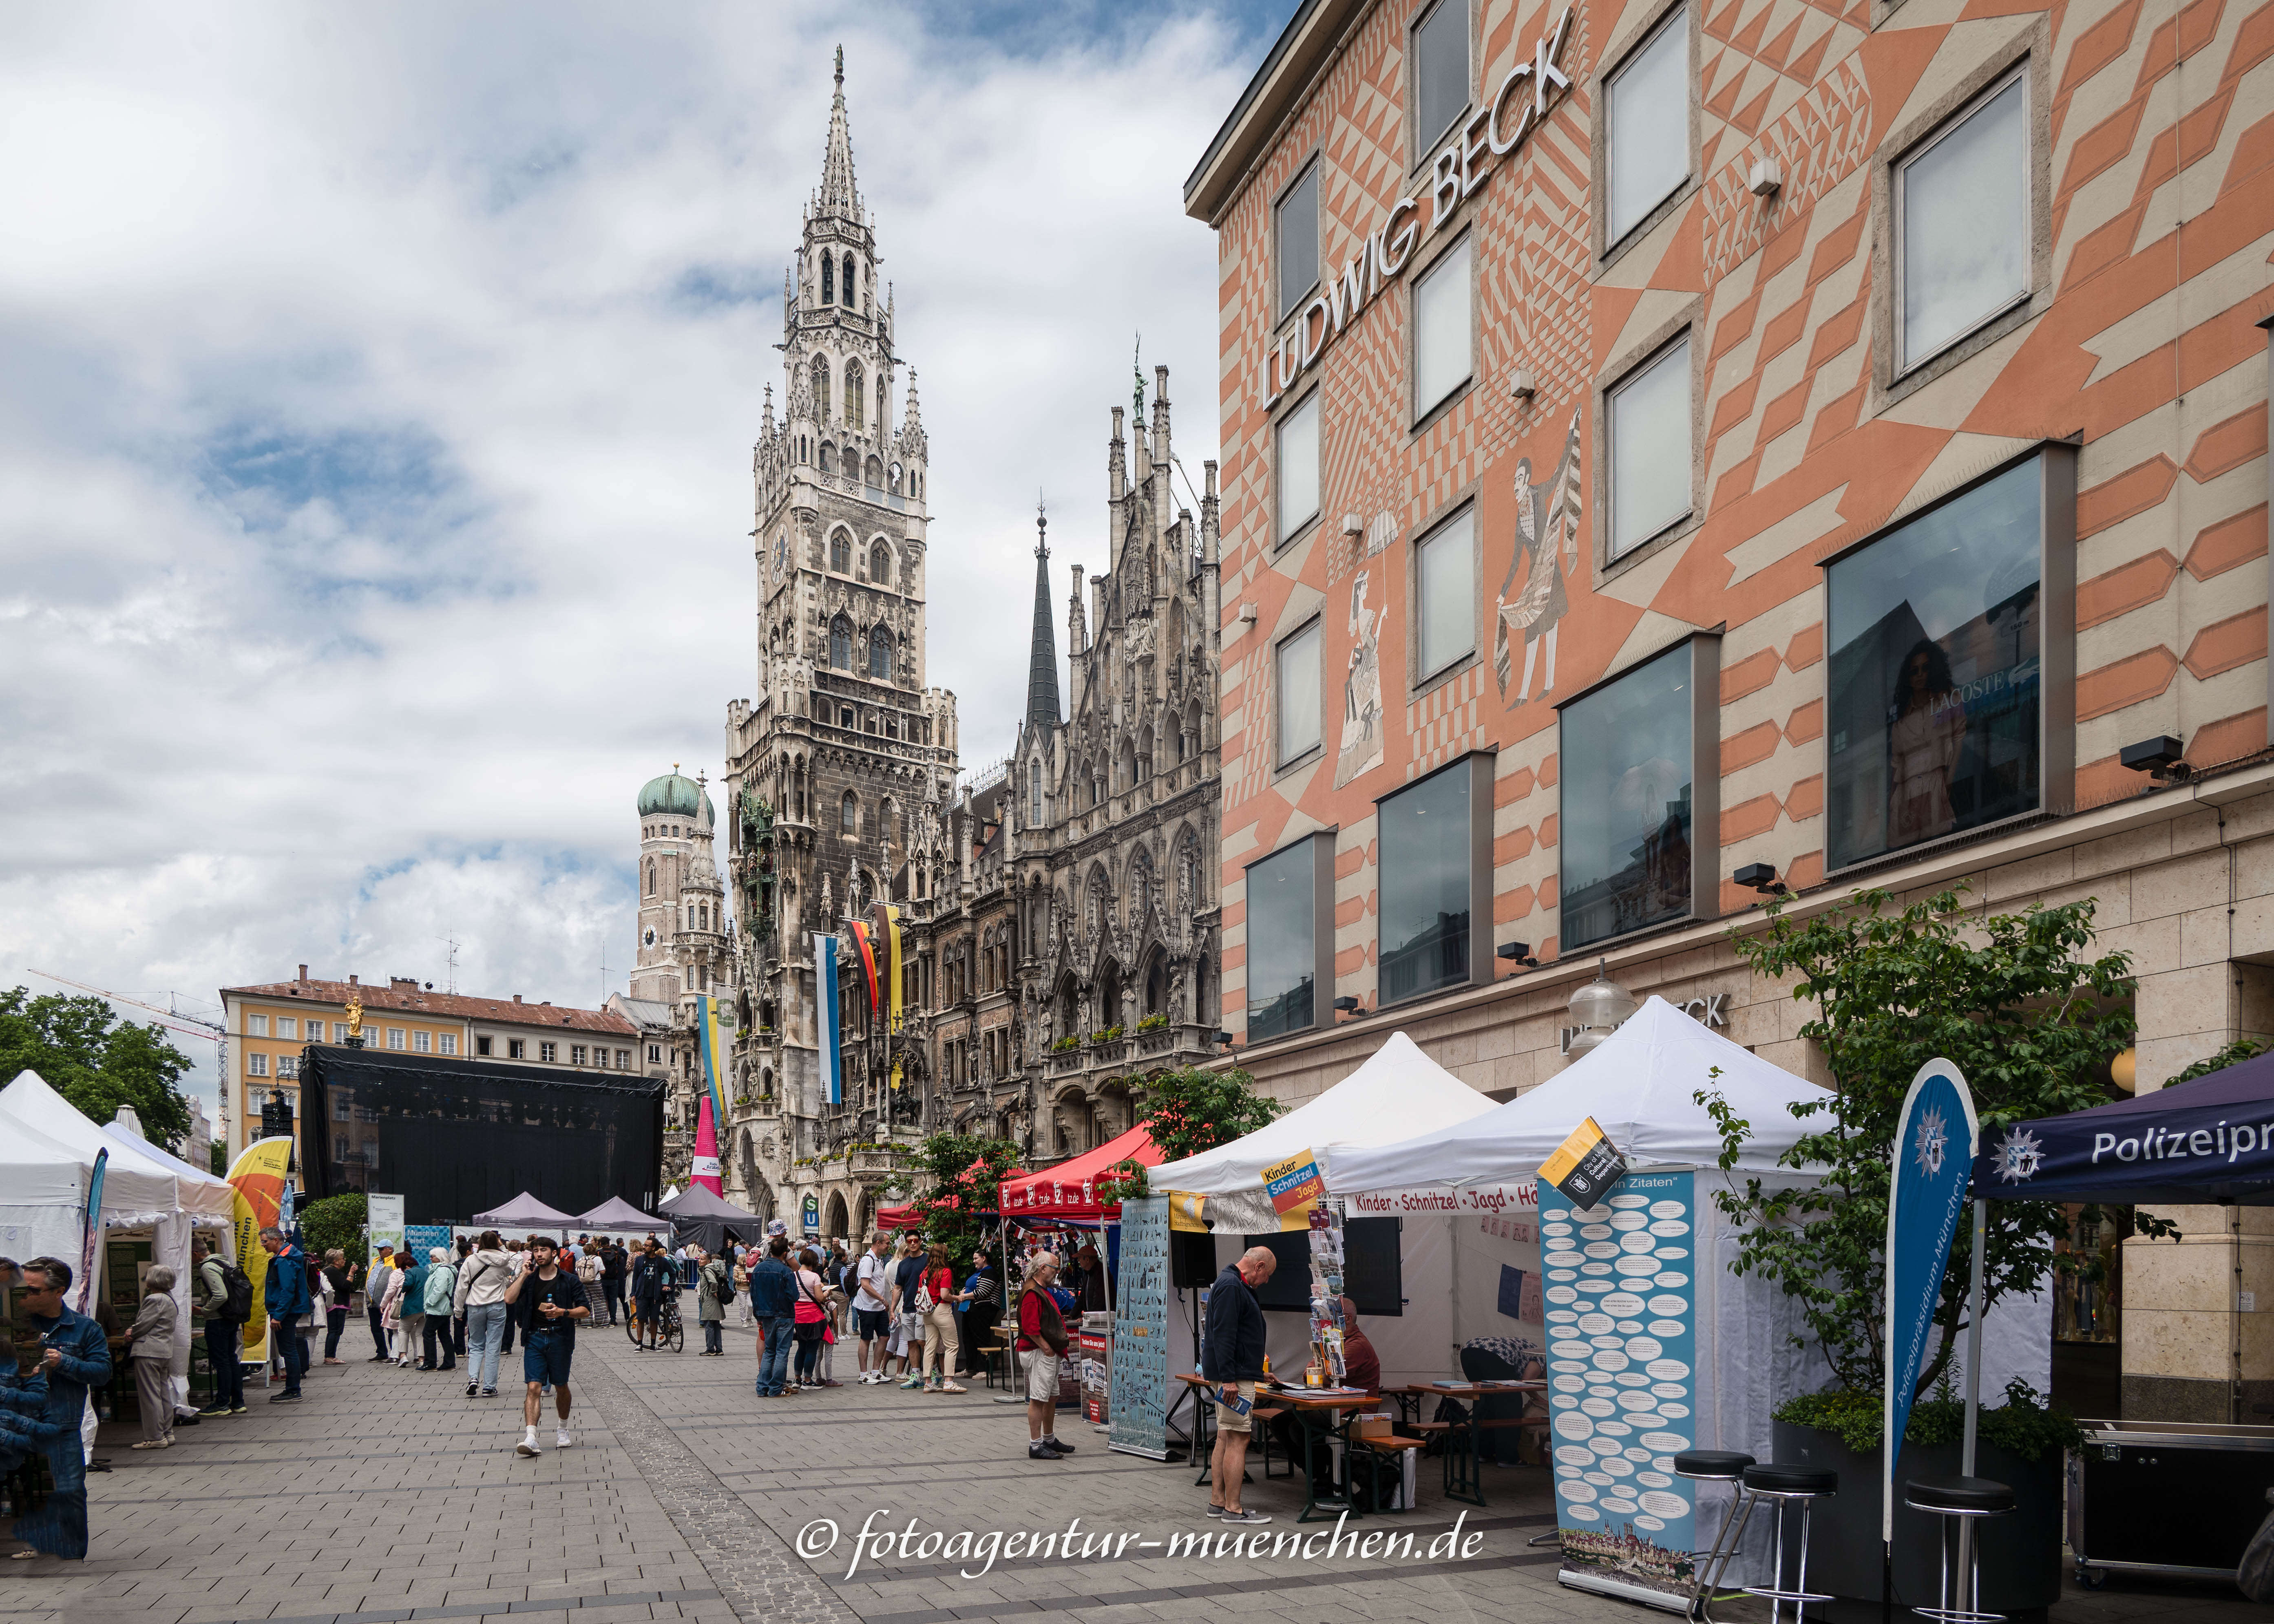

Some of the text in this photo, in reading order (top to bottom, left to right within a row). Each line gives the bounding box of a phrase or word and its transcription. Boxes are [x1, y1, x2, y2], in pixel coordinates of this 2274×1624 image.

[1263, 7, 1572, 412] LUDWIG BECK
[1929, 671, 2005, 717] LACOSTE
[2092, 1120, 2274, 1163] Polizeipr
[1583, 1161, 1593, 1171] City
[1595, 1143, 1610, 1158] Munich
[1589, 1157, 1607, 1176] Cultural
[1595, 1155, 1620, 1180] Department
[1264, 1161, 1296, 1182] Kinder
[1271, 1165, 1314, 1195] Schnitzel
[1039, 1193, 1050, 1205] tz.de
[1067, 1192, 1079, 1204] tz.de
[1083, 1179, 1091, 1204] tz
[1295, 1178, 1319, 1199] Jagd
[1355, 1194, 1391, 1212] Kinder
[1401, 1191, 1460, 1211] Schnitzel
[1468, 1187, 1507, 1214] Jagd
[807, 1199, 816, 1210] S
[1014, 1196, 1023, 1207] tz.de
[1124, 1198, 1167, 1207] Bronzekunstwerke
[807, 1214, 815, 1225] U
[1897, 1172, 1964, 1408] Polizeipräsidium München
[1579, 1568, 1680, 1597] stadtgeschichte-muenchen.de
